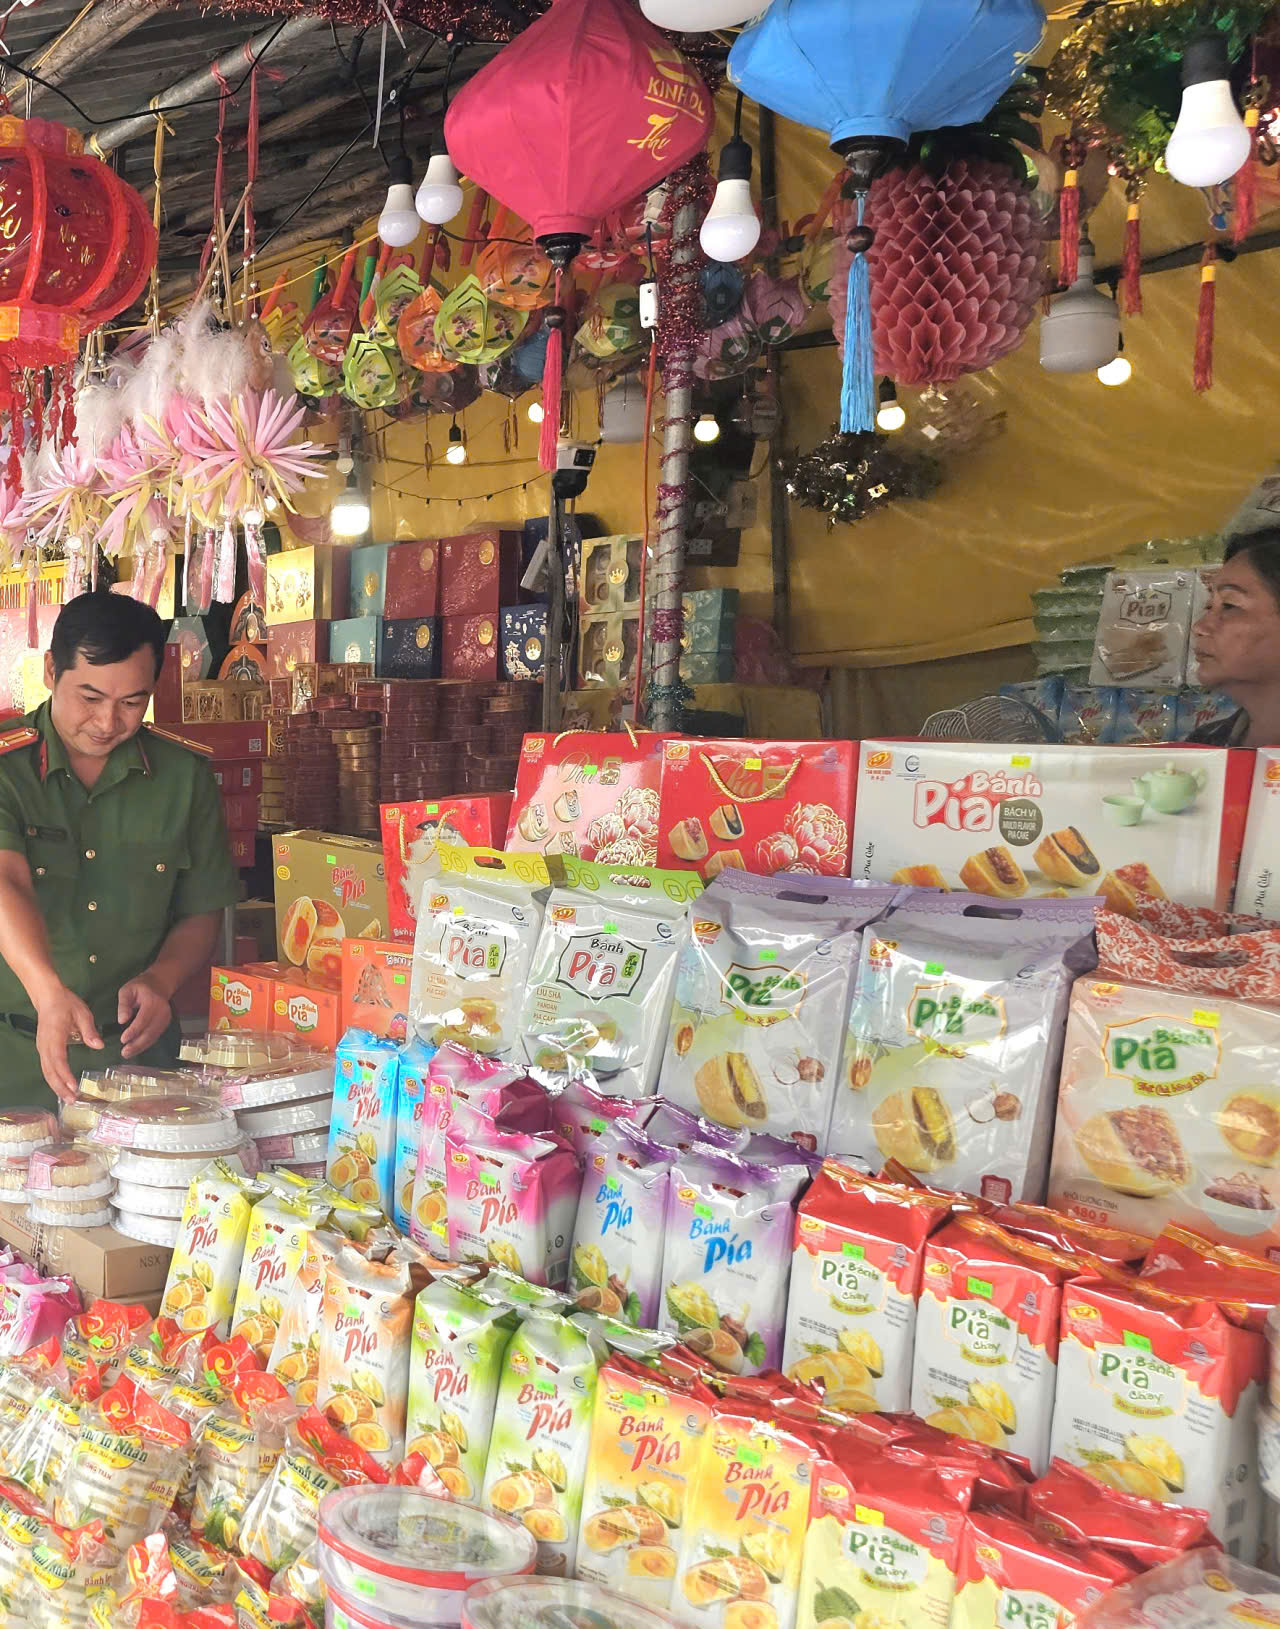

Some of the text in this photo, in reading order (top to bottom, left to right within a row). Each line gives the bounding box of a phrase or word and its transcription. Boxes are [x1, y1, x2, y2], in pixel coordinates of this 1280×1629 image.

[971, 770, 1043, 797] Bánh
[913, 779, 993, 832] Pía
[1004, 806, 1027, 817] BÁCH
[448, 936, 485, 967] Pía
[591, 938, 624, 954] Bánh
[569, 951, 616, 985] Pía
[947, 997, 997, 1016] Bnh
[1112, 1037, 1177, 1070] Pía
[479, 1195, 518, 1233] Pía
[601, 1198, 632, 1235] Pía
[1073, 1205, 1097, 1220] 480
[188, 1223, 218, 1256] Pía
[703, 1233, 752, 1273] Pía
[139, 1256, 161, 1268] NSX
[255, 1256, 286, 1291] Pía
[822, 1259, 858, 1290] Pía
[951, 1306, 989, 1339] Pía
[344, 1325, 378, 1363] Pía
[434, 1367, 468, 1402] Pía
[1101, 1352, 1149, 1389] Pía
[526, 1399, 572, 1440] Pía
[619, 1414, 665, 1436] Bánh
[631, 1432, 680, 1472] Pía
[735, 1481, 790, 1521] Pía
[850, 1531, 895, 1565] Pía
